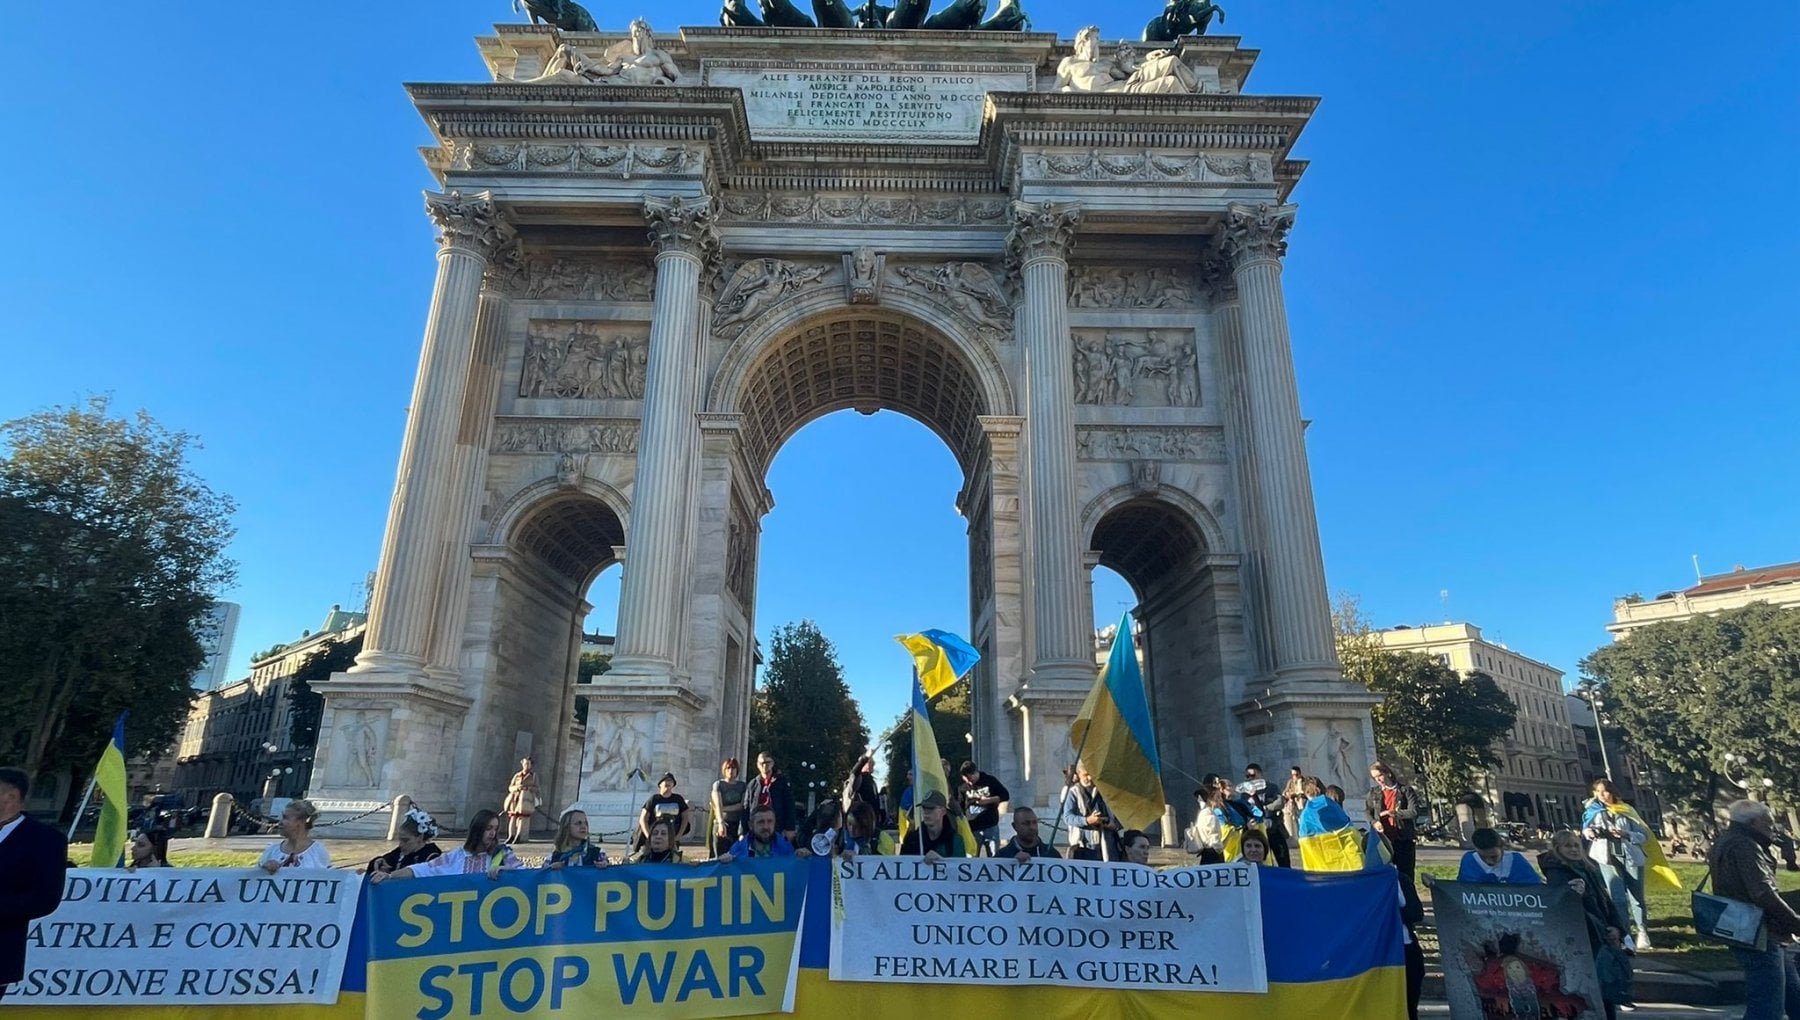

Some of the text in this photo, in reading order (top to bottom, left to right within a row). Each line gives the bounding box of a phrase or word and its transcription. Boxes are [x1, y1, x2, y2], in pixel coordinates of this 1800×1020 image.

[797, 74, 854, 82] SPERANZE
[750, 91, 804, 99] MILANESI
[812, 92, 884, 100] DEDICARONO
[811, 101, 865, 109] FRANCATI
[787, 109, 952, 119] FELICEMENTE RESTITUIRONO
[863, 120, 926, 128] MDCCCLIX
[840, 860, 1251, 889] SI ALLE SANZIONI EUROPEE
[61, 877, 341, 904] D'ITALIA UNITI
[1462, 892, 1548, 909] MARIUPOL
[396, 872, 786, 948] STOP PUTIN
[894, 892, 1195, 922] CONTRO LA RUSSIA,
[26, 922, 341, 949] ATRIA E CONTRO
[912, 924, 1180, 951] UNICO MODO PER
[174, 968, 320, 996] RUSSA!
[416, 946, 767, 1020] STOP WAR
[874, 956, 1218, 986] FERMARE LA GUERRA!
